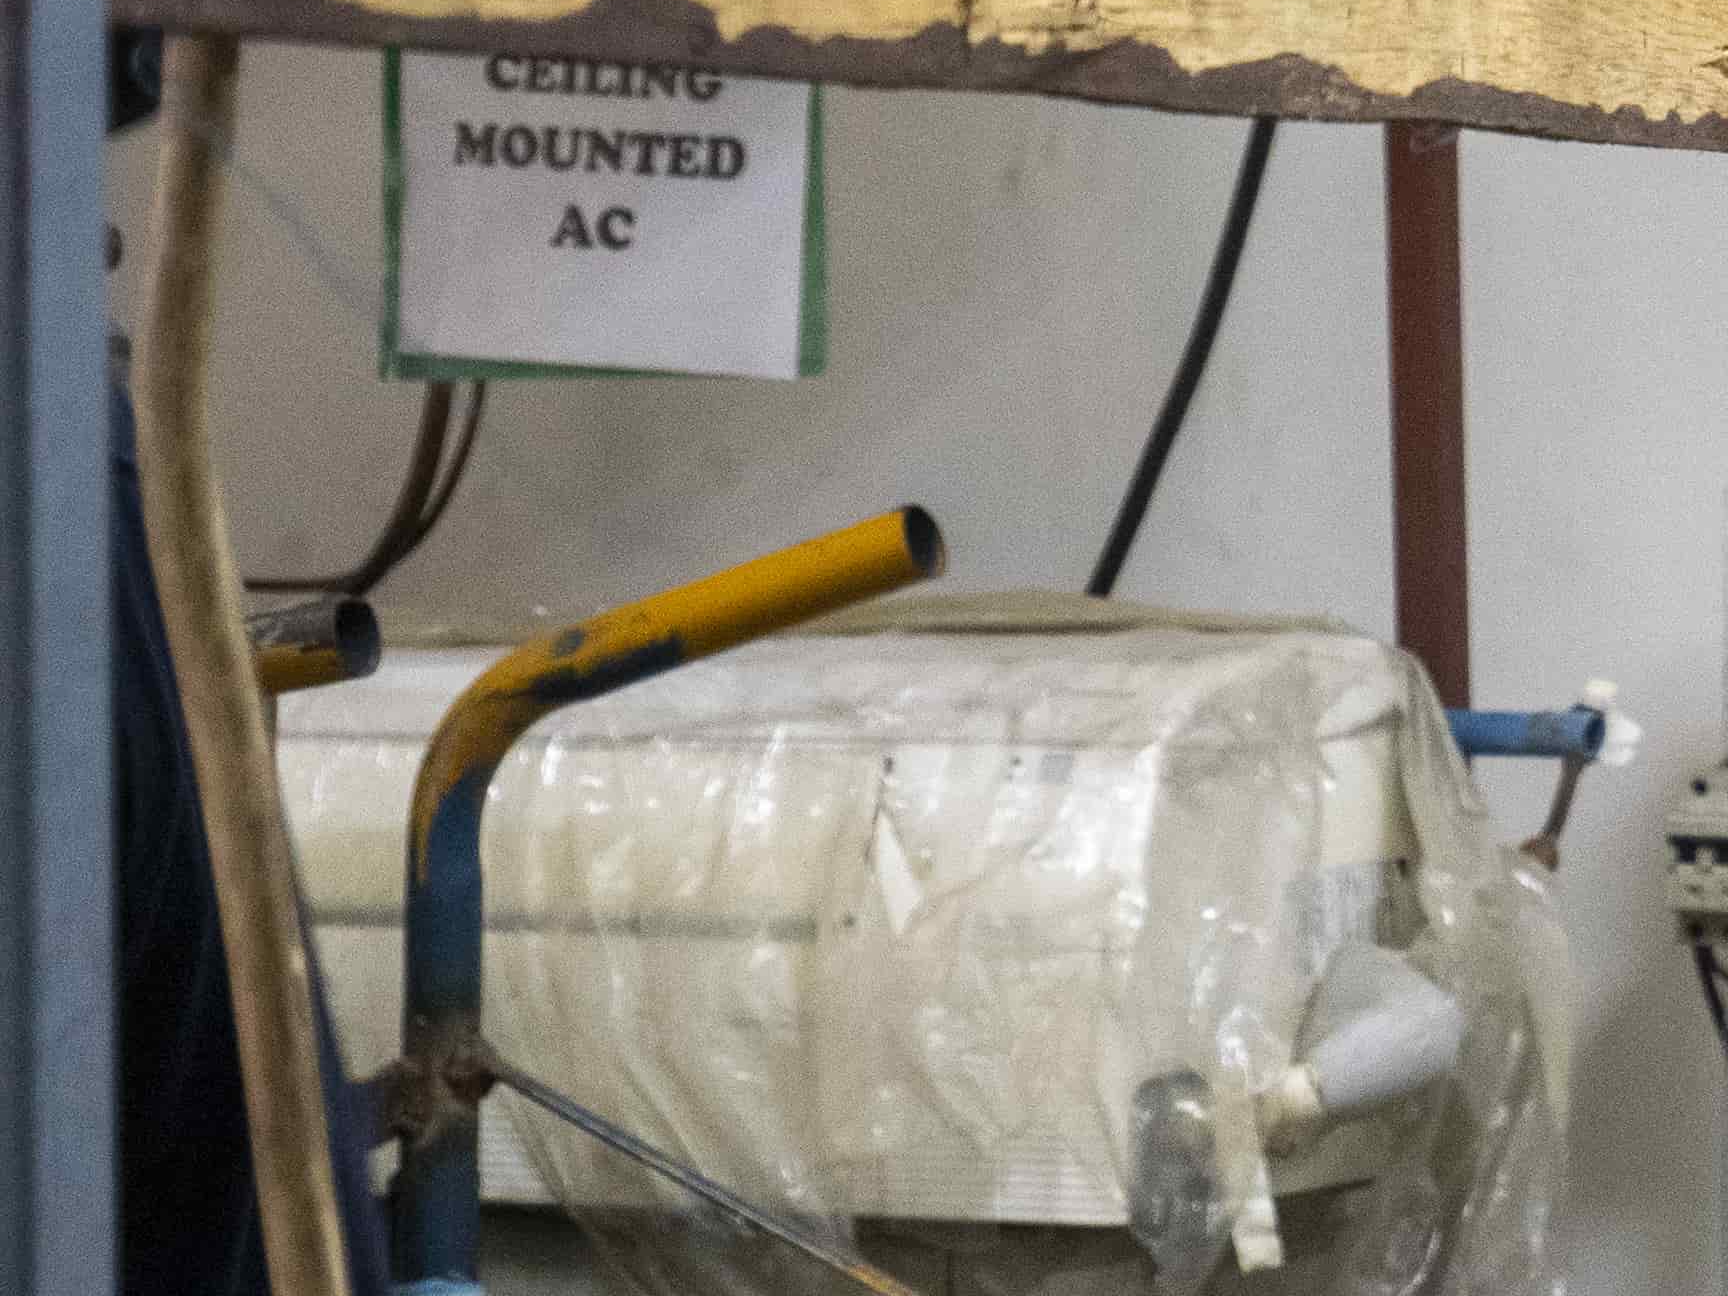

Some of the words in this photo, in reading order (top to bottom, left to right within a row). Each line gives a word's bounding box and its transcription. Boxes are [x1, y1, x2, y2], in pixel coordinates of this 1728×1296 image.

[485, 55, 723, 102] CEILING
[455, 121, 746, 181] MOUNTED
[550, 205, 638, 251] AC
